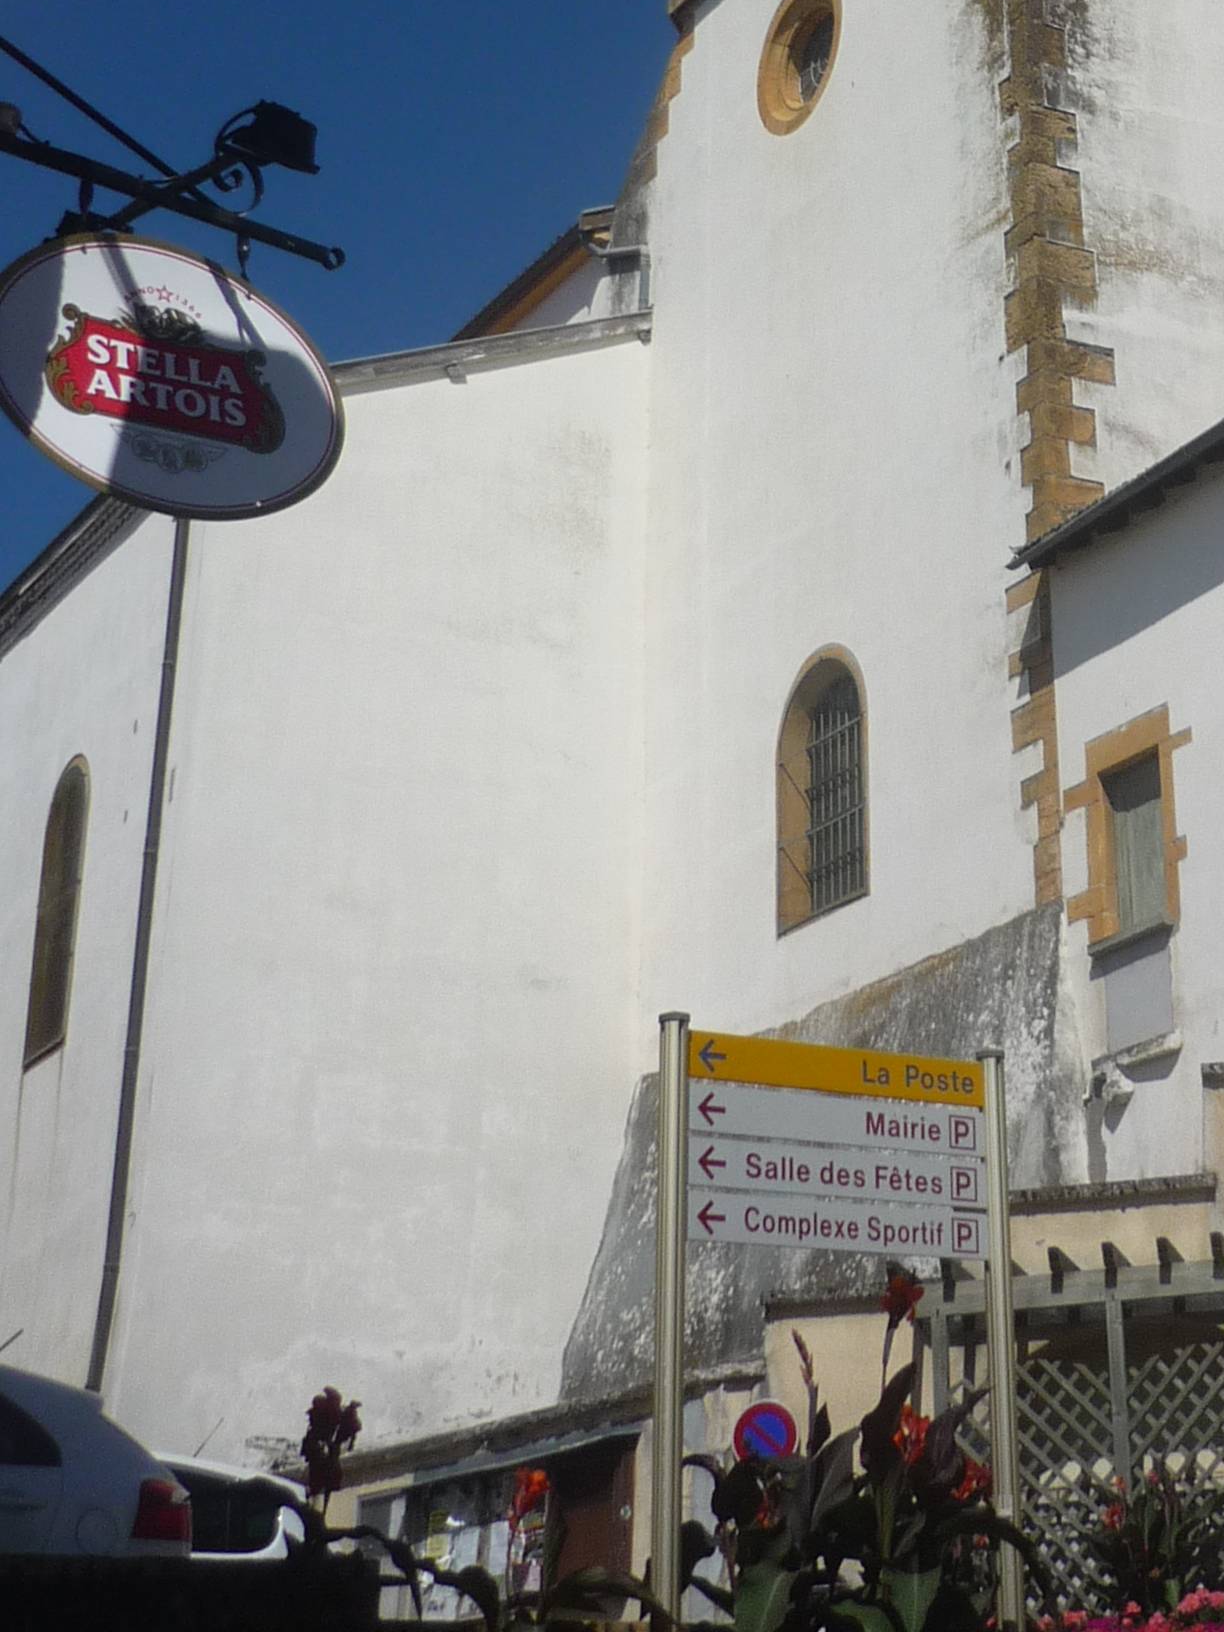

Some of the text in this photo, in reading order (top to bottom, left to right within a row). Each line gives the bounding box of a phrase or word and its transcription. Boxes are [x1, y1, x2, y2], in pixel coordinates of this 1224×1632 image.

[86, 334, 243, 394] STELLA
[86, 369, 247, 427] ARTOIS
[862, 1059, 975, 1094] La Poste
[865, 1111, 970, 1146] Mairie P
[746, 1152, 971, 1197] Salle des Fêtes P
[744, 1206, 973, 1249] Complexe Sportif P
